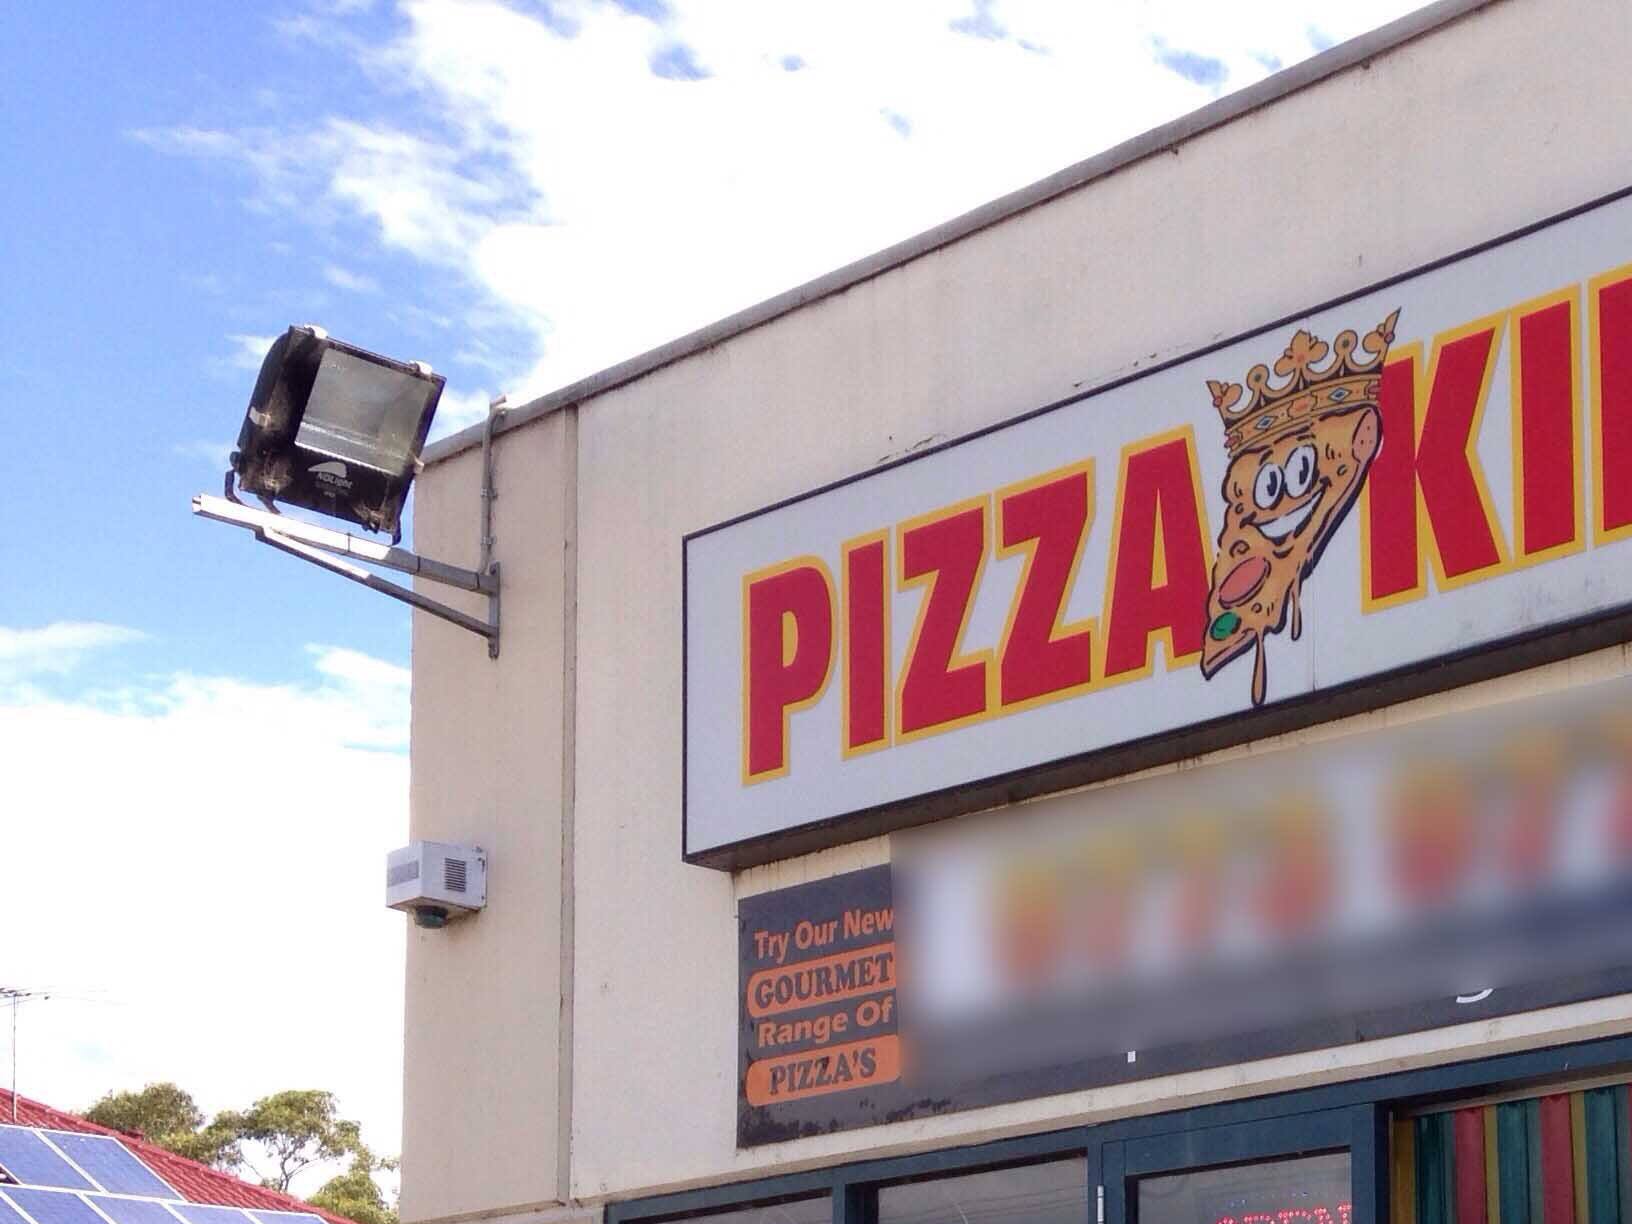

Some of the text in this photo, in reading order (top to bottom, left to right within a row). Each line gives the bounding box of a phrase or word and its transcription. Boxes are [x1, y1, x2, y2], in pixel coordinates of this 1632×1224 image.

[743, 423, 1212, 787] PIZZA
[754, 908, 895, 964] Try Our New
[754, 952, 893, 1009] GOURMET
[757, 996, 894, 1048] Range Of
[768, 1048, 877, 1096] PIZZA'S
